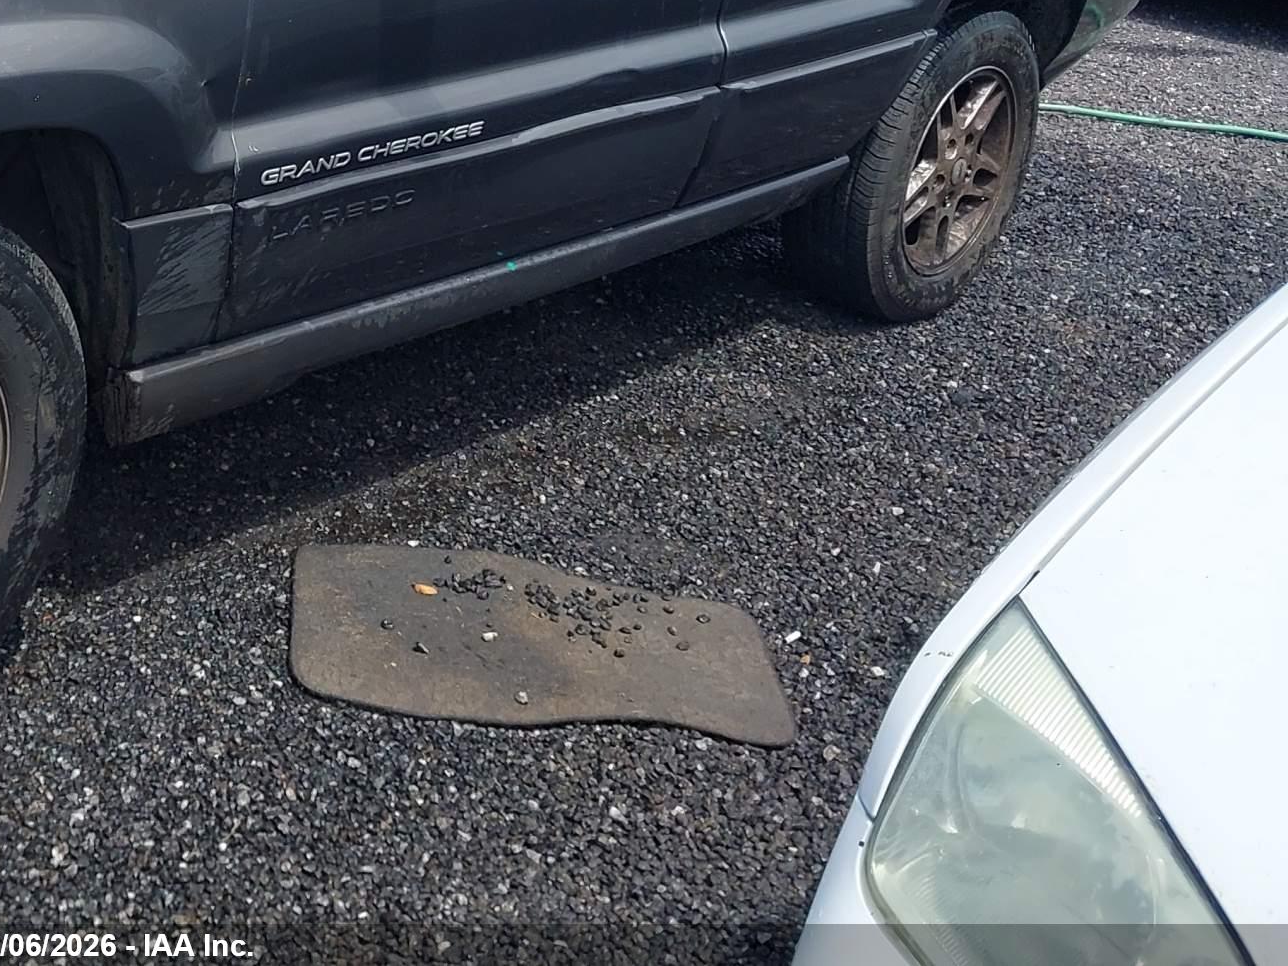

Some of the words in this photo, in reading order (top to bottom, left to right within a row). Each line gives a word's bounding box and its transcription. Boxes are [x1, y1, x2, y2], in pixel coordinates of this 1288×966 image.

[261, 151, 352, 185] GRAND
[357, 120, 486, 162] CHEROKEE
[270, 188, 416, 240] LAREDO
